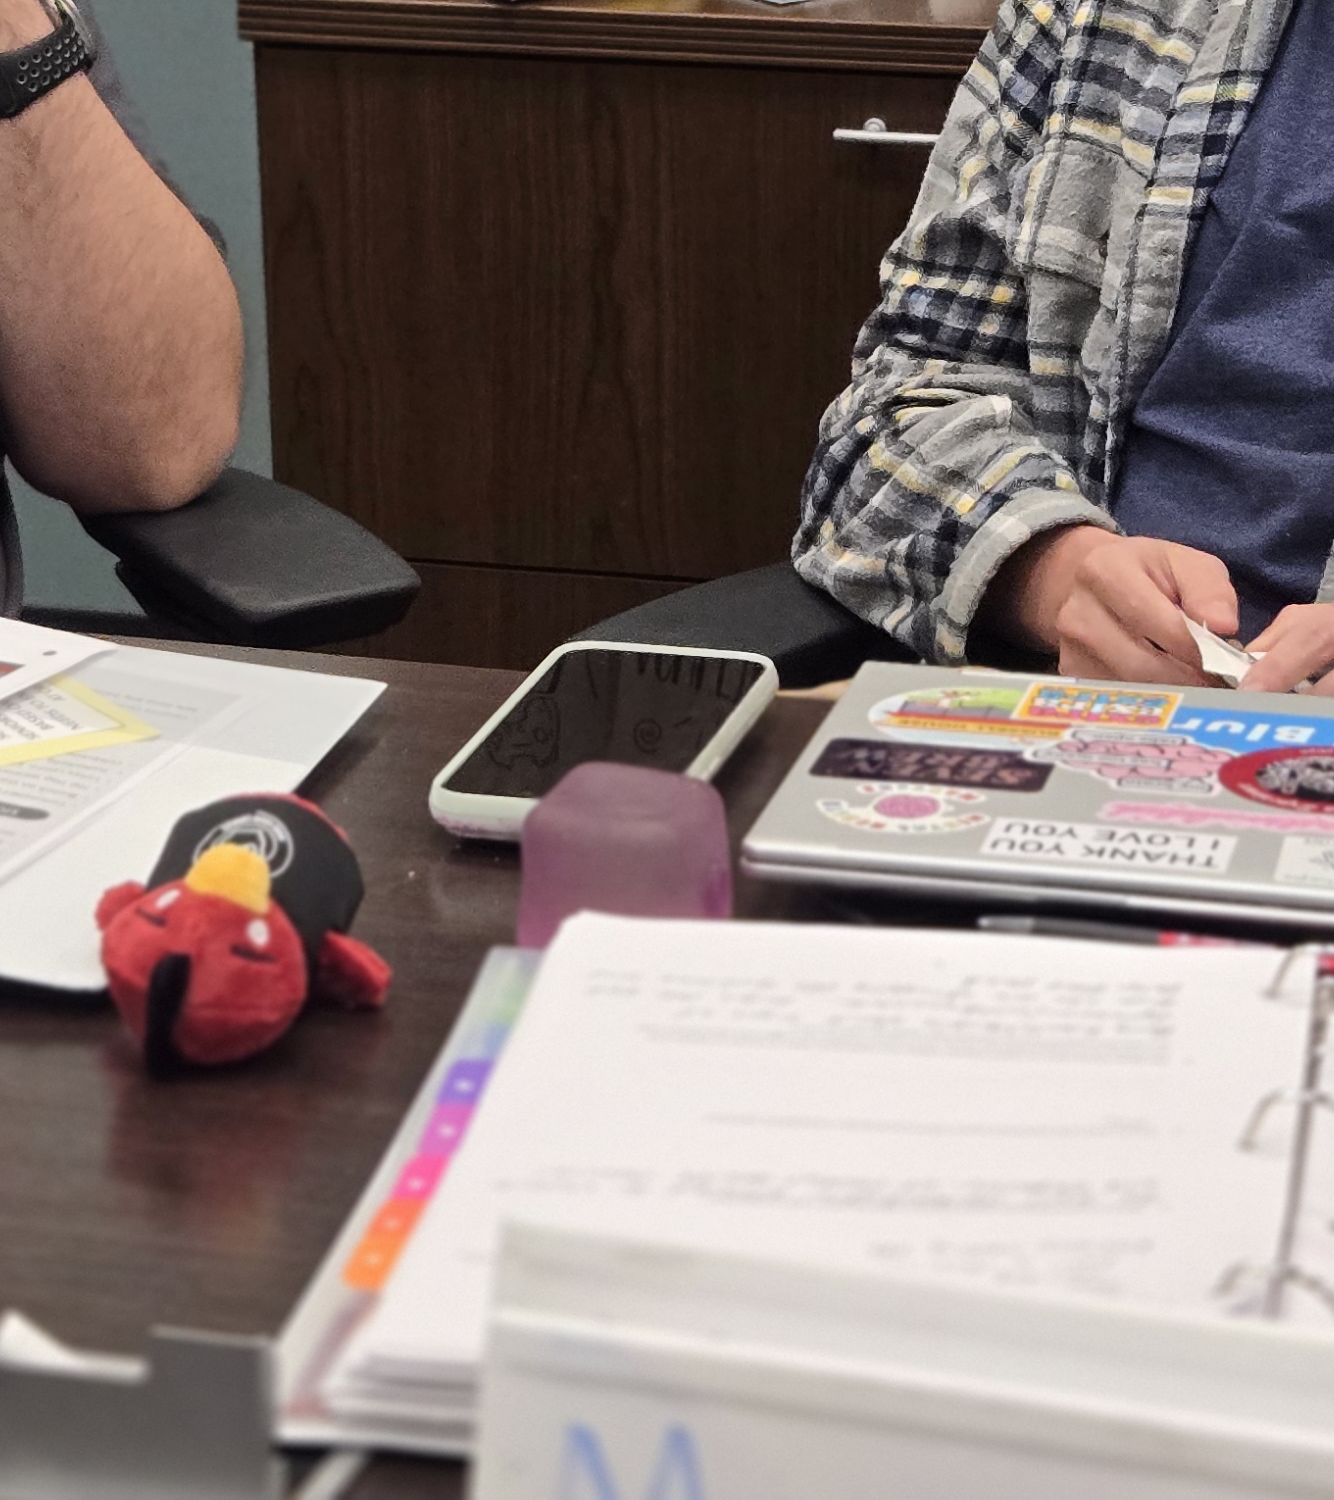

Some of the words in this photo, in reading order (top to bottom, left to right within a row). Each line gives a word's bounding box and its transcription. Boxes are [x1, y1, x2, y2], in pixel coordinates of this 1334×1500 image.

[1171, 717, 1317, 746] Blur
[1003, 819, 1084, 843] YOU
[1092, 825, 1197, 848] LOVE
[1210, 834, 1221, 851] I
[990, 833, 1079, 859] YOU
[1082, 839, 1220, 869] THANK
